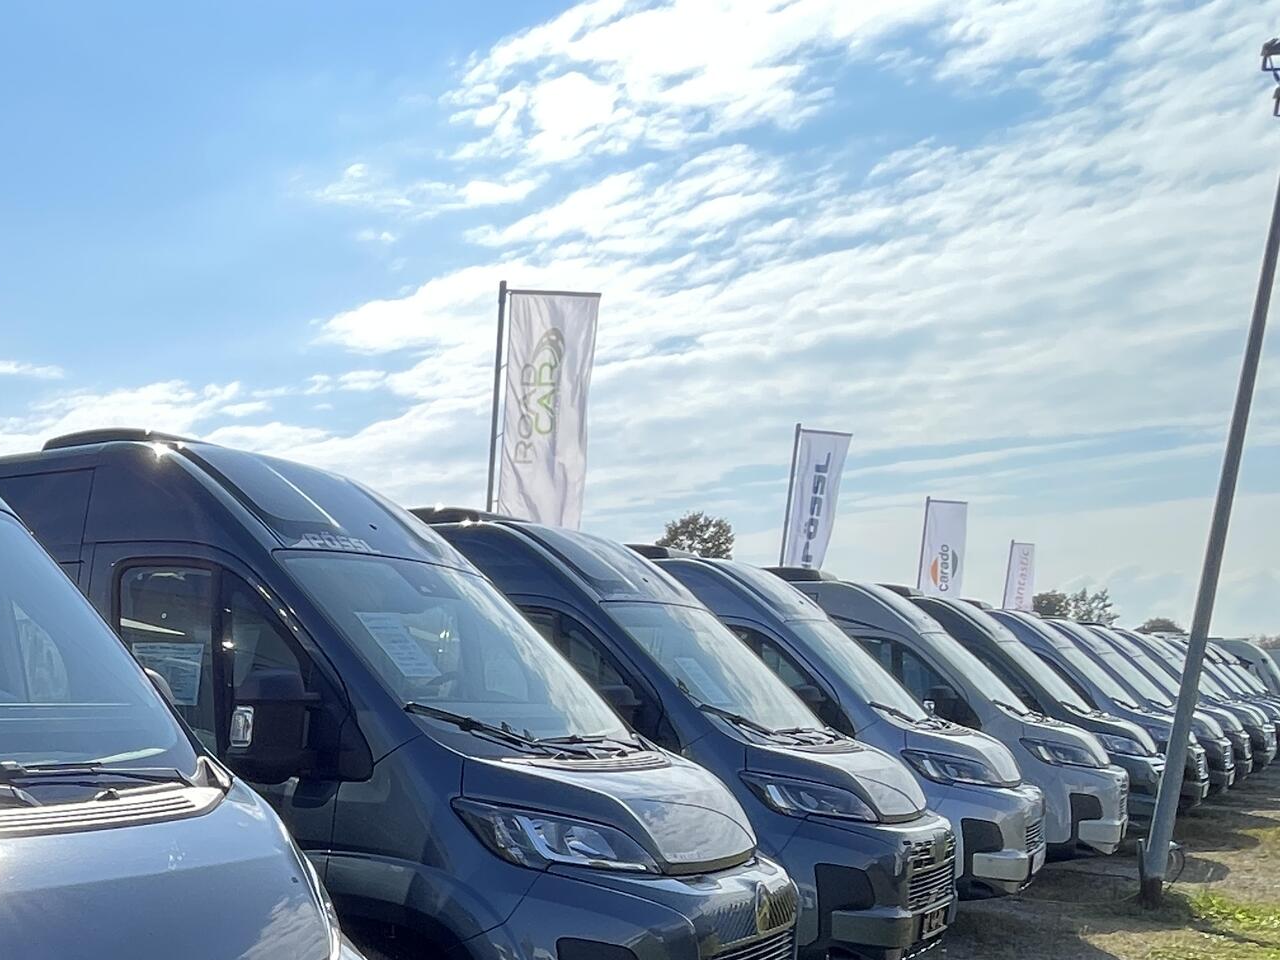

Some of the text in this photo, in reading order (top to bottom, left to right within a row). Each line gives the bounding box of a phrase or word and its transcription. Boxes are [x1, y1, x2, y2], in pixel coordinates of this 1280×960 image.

[513, 363, 538, 464] ROAD
[535, 361, 558, 435] CAR
[304, 531, 382, 553] PÖSSL
